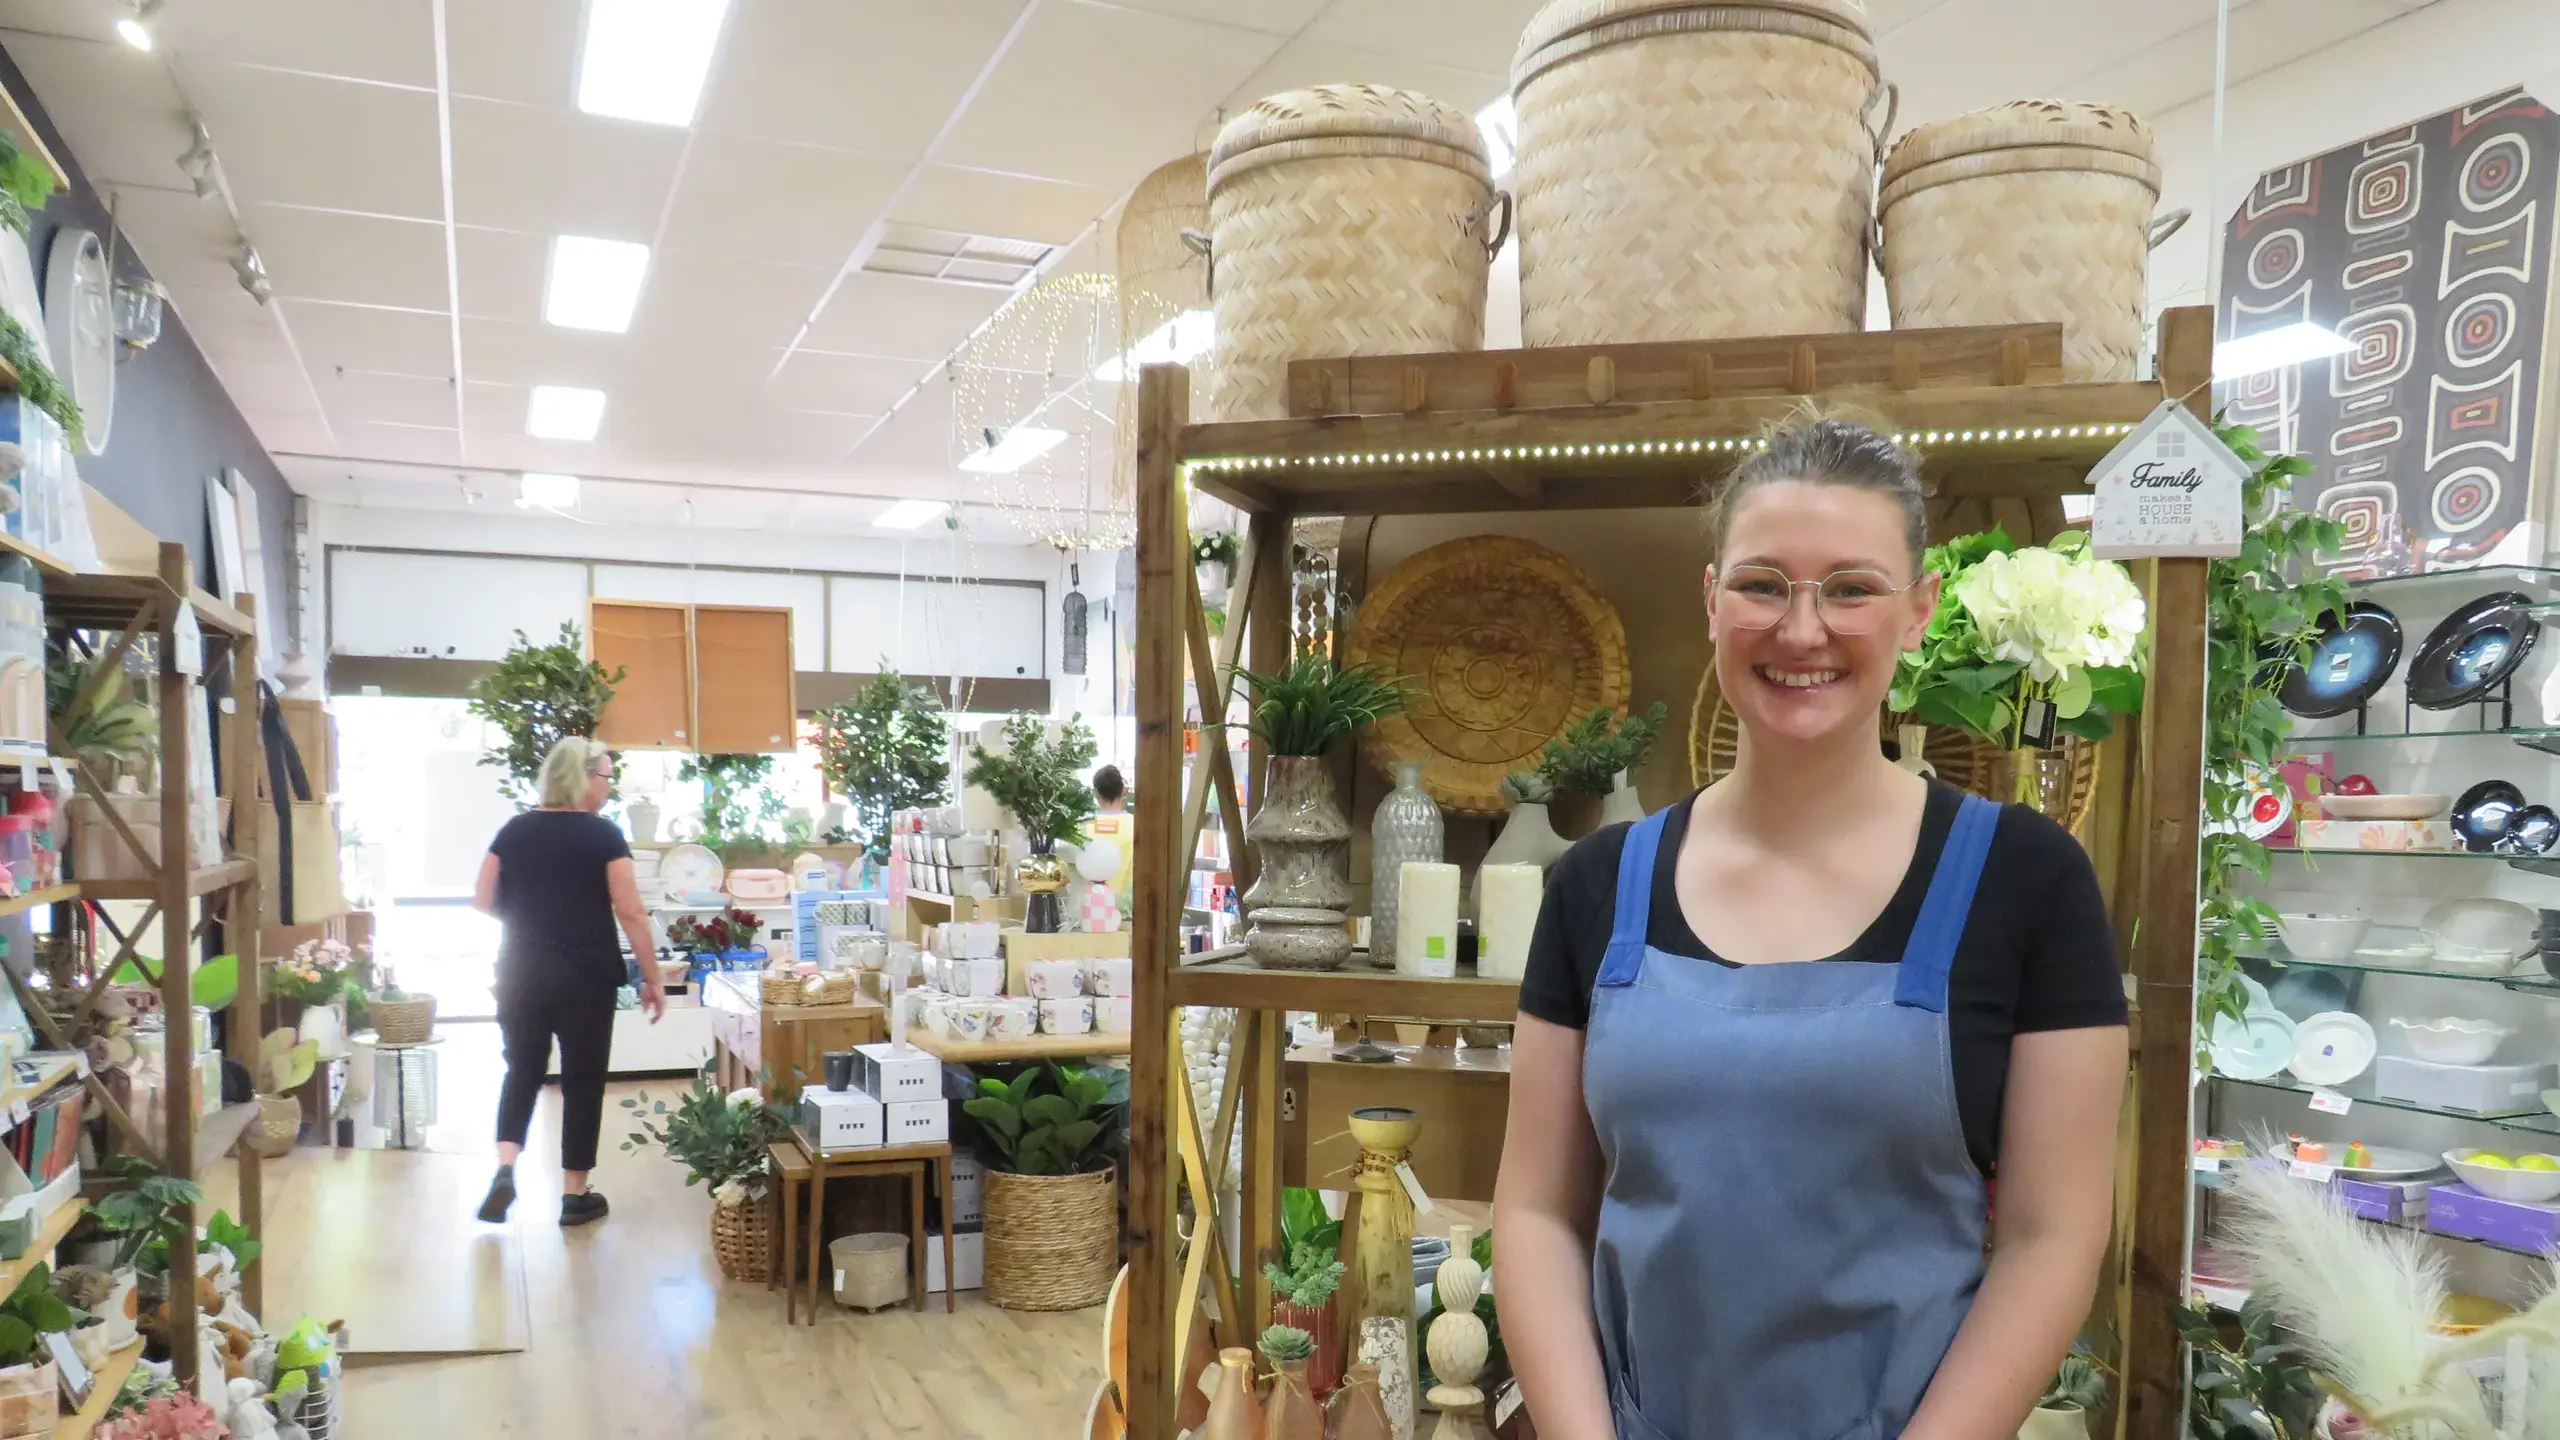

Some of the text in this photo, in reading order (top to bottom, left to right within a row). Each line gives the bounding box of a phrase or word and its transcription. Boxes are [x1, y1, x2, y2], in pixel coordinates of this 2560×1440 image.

[2130, 462, 2203, 493] Family
[2140, 494, 2181, 502] makes
[2140, 504, 2192, 515] HOUSE
[2140, 516, 2191, 525] a home
